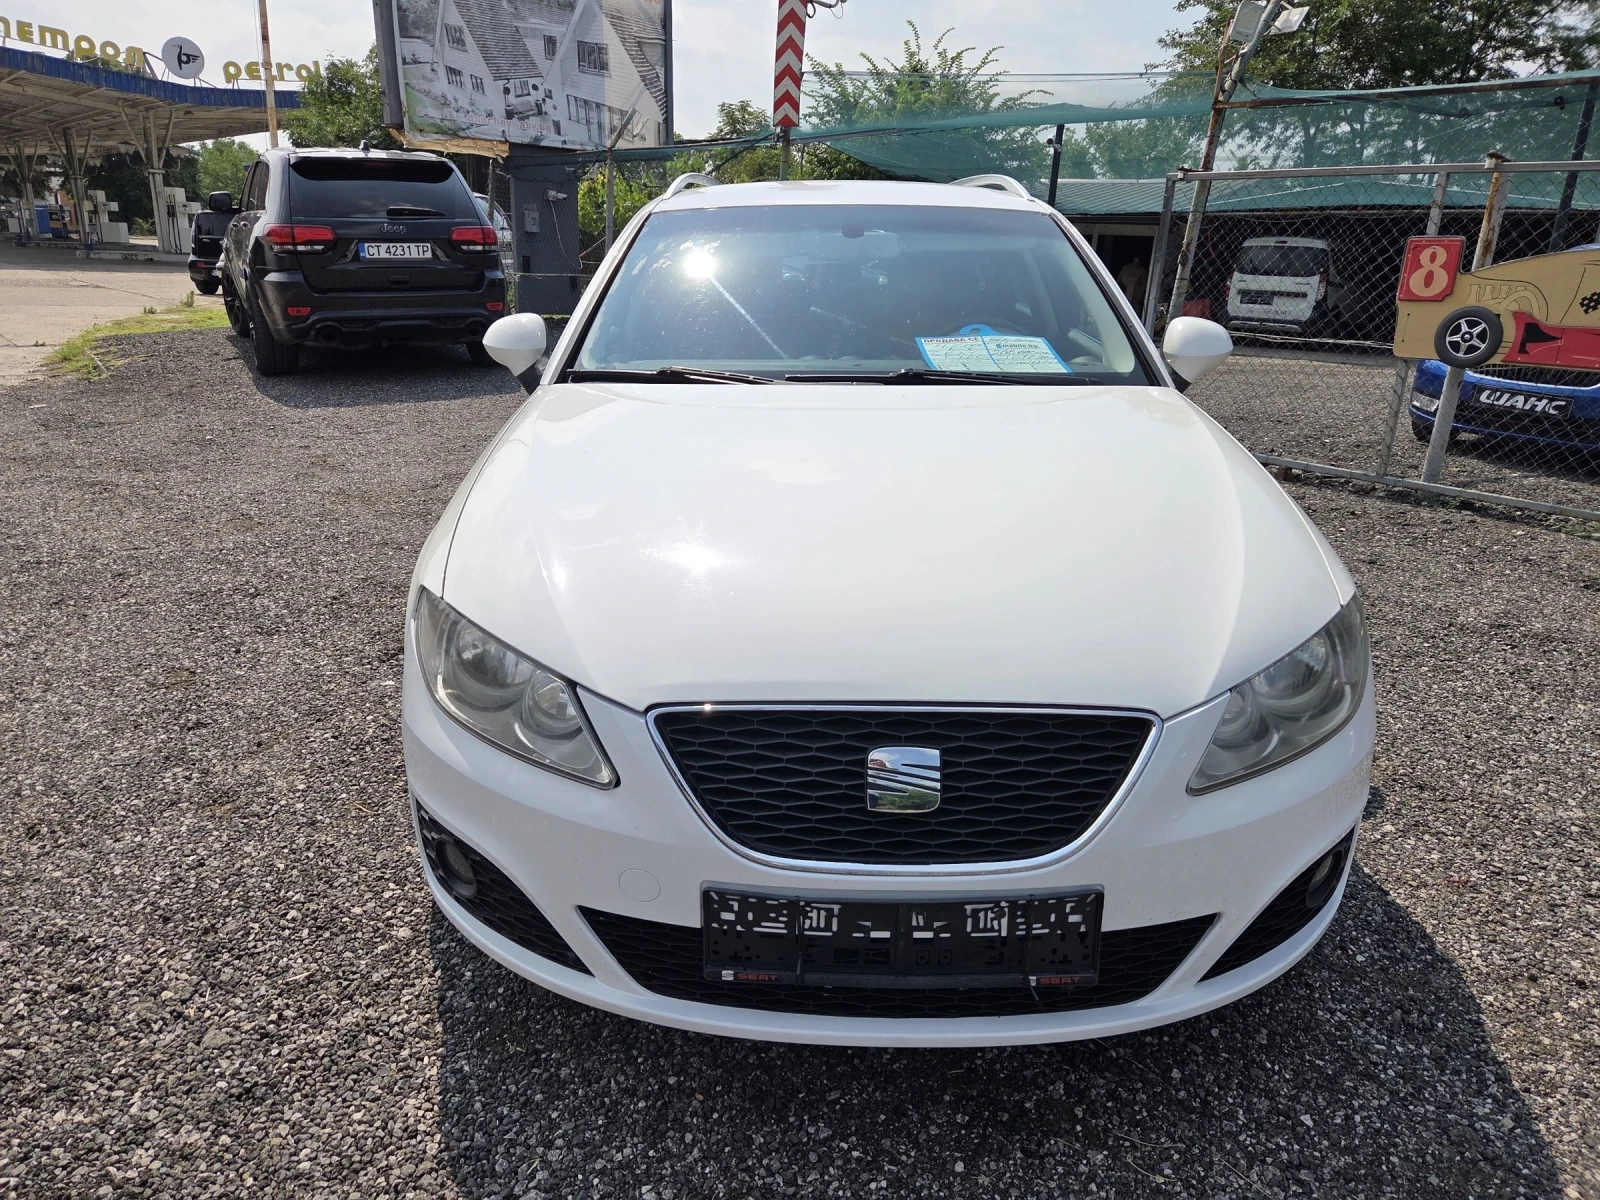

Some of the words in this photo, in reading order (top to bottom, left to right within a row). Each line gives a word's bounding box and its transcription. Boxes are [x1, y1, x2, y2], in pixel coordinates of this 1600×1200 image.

[222, 60, 322, 84] perol
[380, 223, 407, 235] Jeep
[367, 245, 382, 256] CT
[385, 245, 412, 256] 4231
[414, 245, 430, 256] TP
[1409, 245, 1449, 297] 8
[1479, 389, 1566, 415] ШАНС
[737, 973, 778, 981] SEAT
[1040, 977, 1080, 985] SEAT
